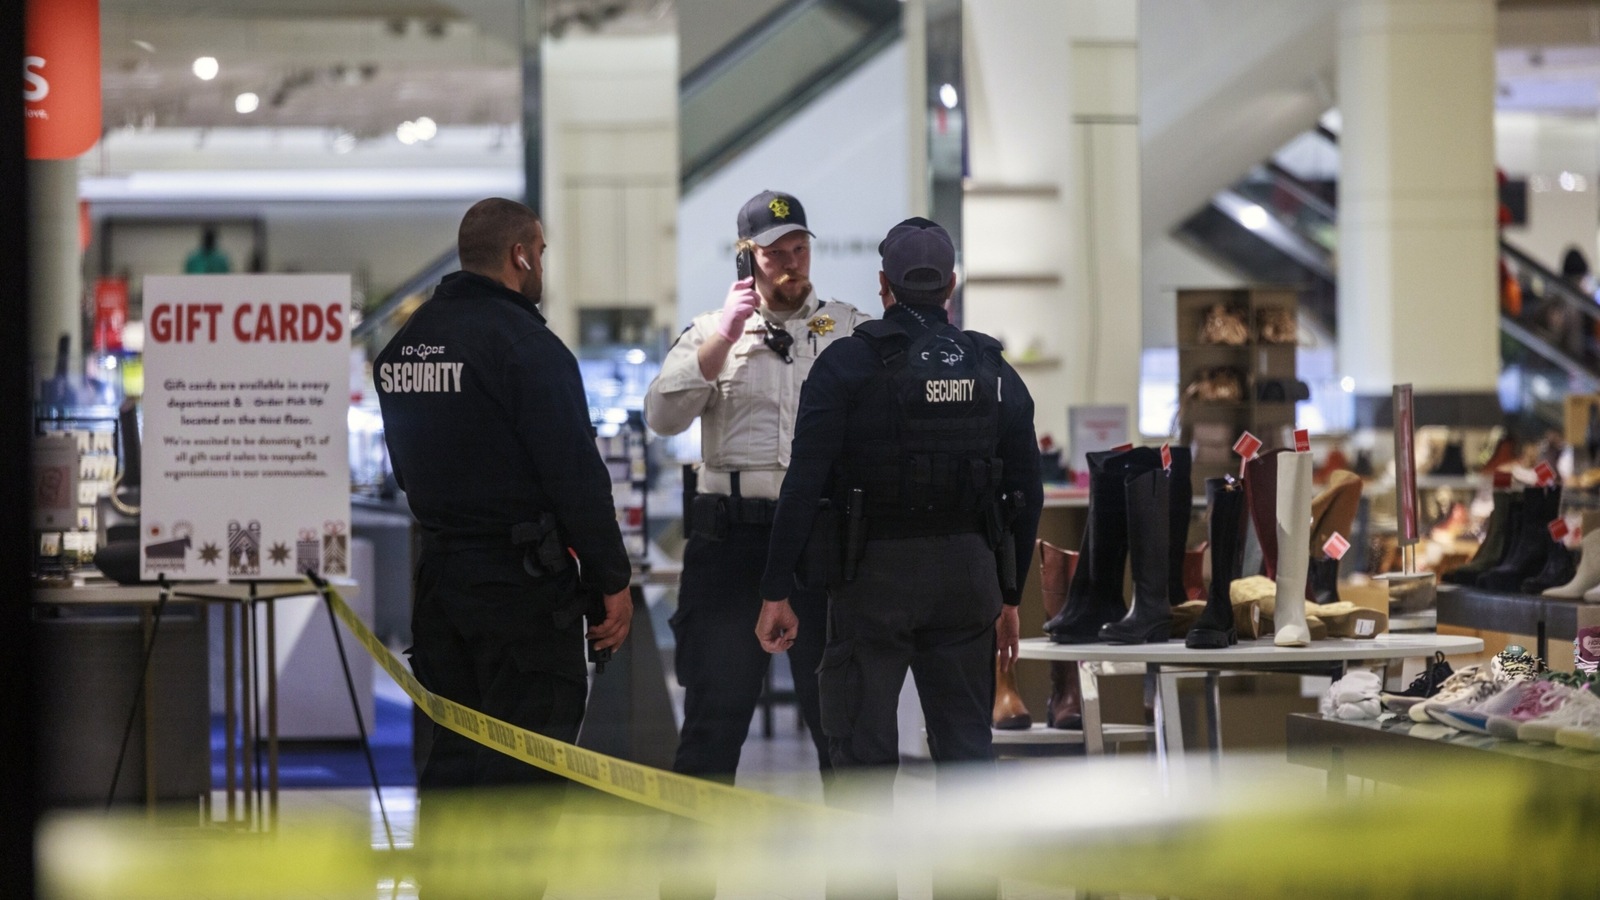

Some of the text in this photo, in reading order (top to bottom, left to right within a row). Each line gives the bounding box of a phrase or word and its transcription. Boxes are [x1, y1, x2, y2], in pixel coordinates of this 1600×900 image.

[150, 303, 343, 343] GIFT CARDS
[380, 362, 464, 393] SECURITY
[164, 379, 330, 395] Gift cards are available in every
[926, 379, 975, 402] SECURITY
[167, 397, 324, 411] department & Order Pick Up
[181, 415, 220, 426] located
[238, 415, 256, 425] the
[283, 414, 313, 425] floor.
[193, 435, 230, 446] excited
[231, 437, 242, 446] to
[243, 435, 255, 445] be
[257, 435, 302, 449] donating
[319, 435, 331, 446] of
[189, 451, 207, 465] gift
[209, 451, 231, 462] card
[258, 453, 269, 461] to
[271, 451, 318, 465] nonprofit
[231, 468, 241, 477] in
